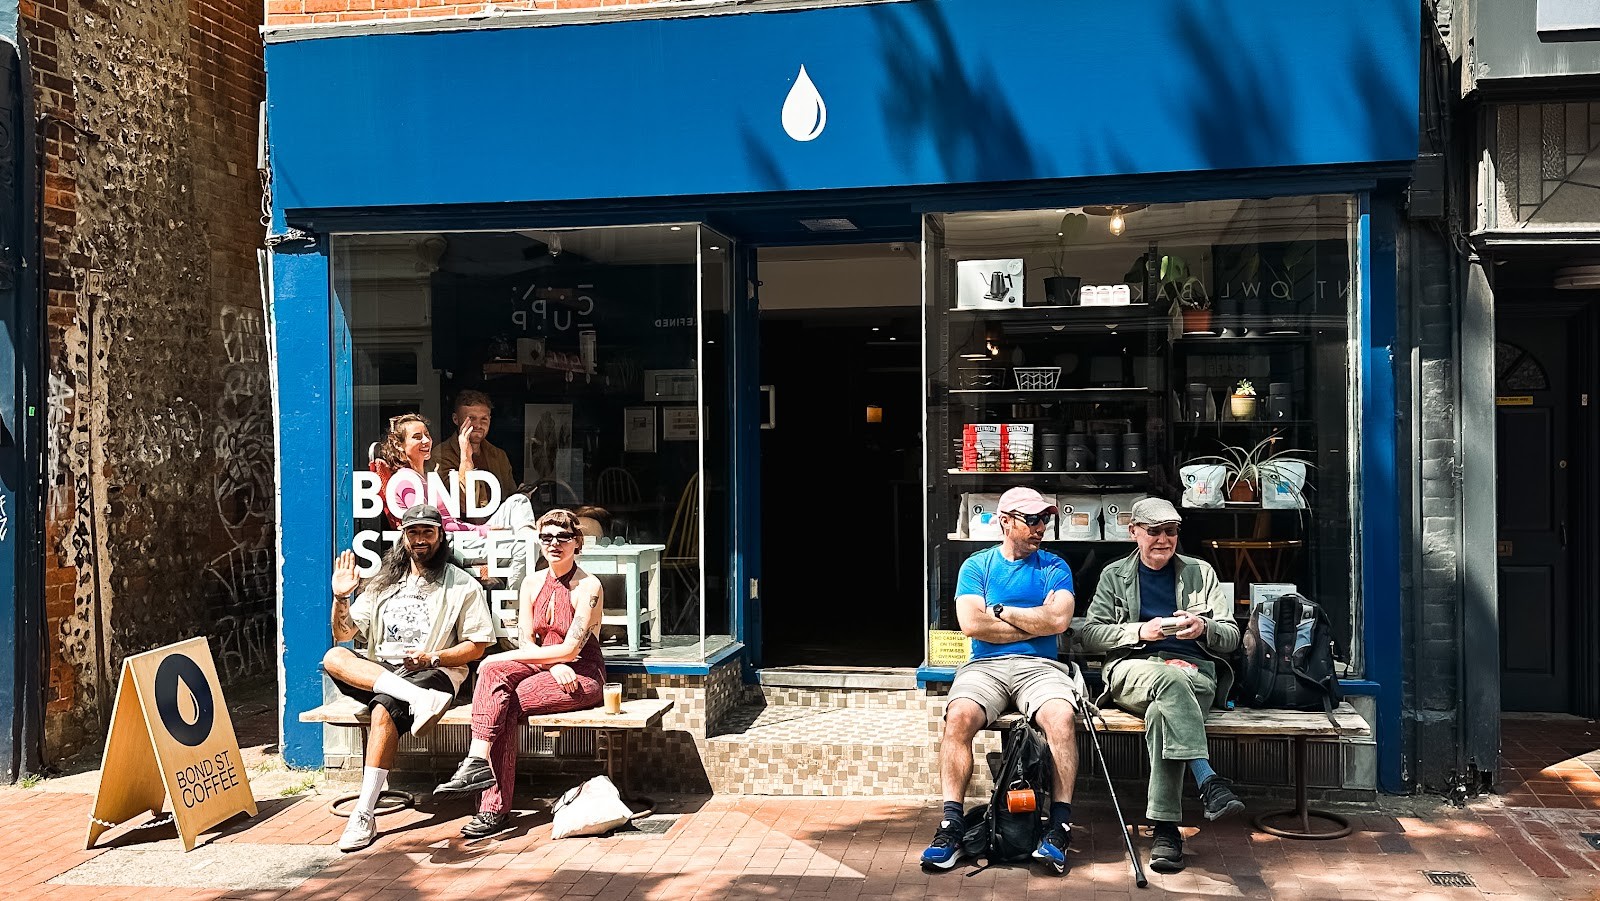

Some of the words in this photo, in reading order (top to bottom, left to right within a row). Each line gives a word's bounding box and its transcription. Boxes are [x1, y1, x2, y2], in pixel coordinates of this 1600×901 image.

[353, 470, 501, 519] BOND
[352, 529, 540, 579] STEET
[176, 759, 213, 789] BOND
[215, 750, 234, 770] ST.
[182, 766, 239, 808] COFFEE
